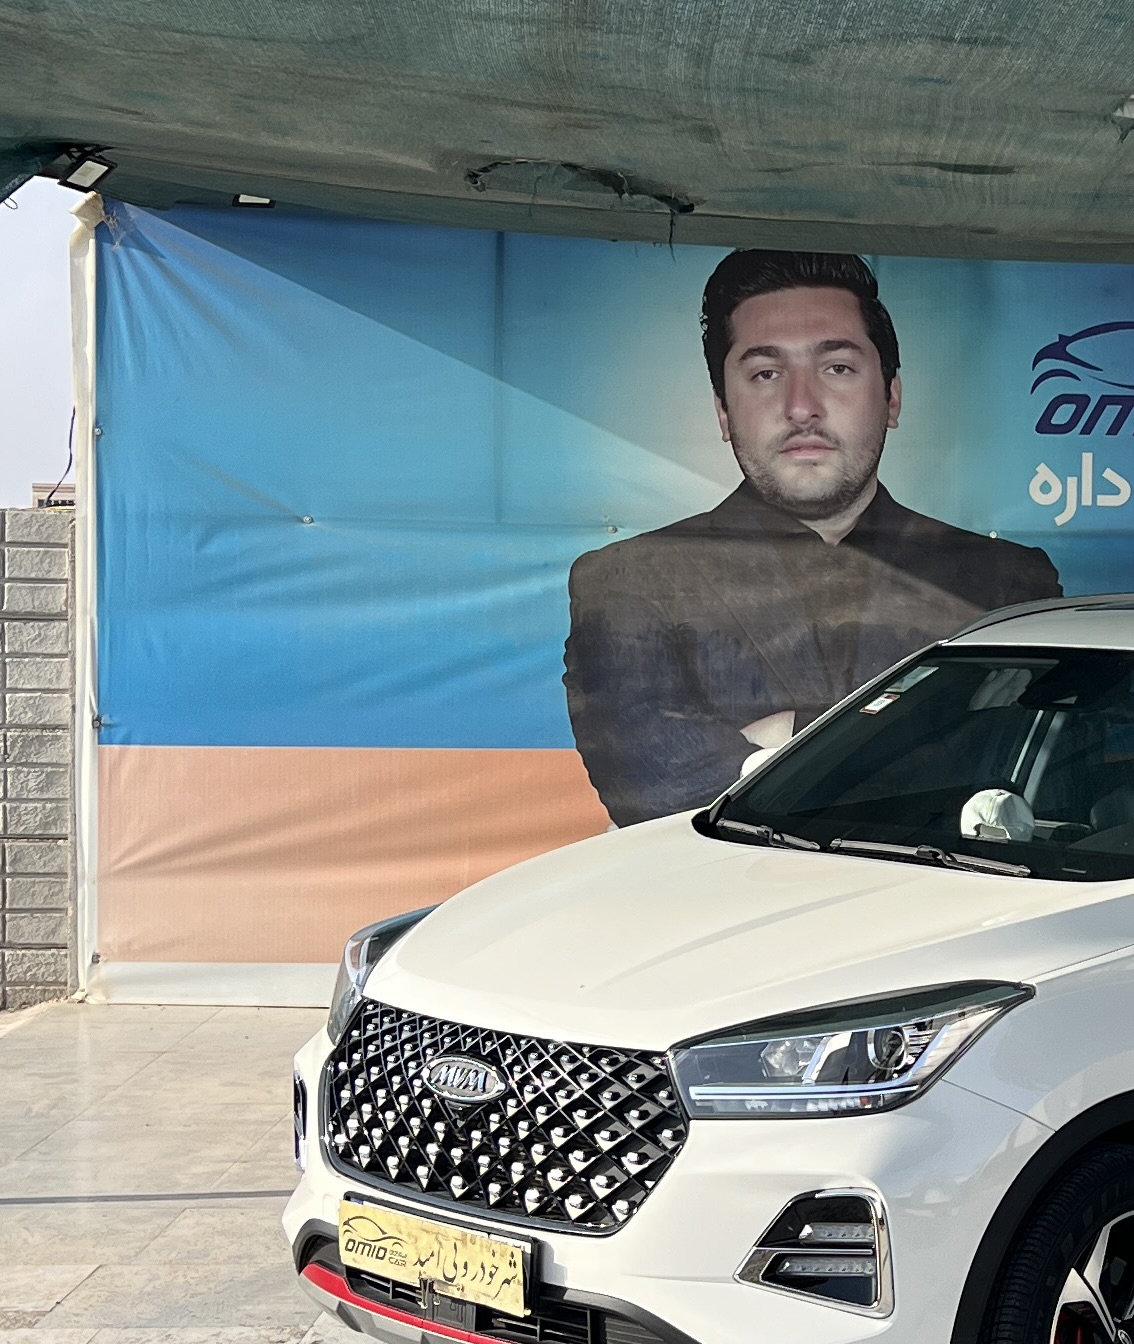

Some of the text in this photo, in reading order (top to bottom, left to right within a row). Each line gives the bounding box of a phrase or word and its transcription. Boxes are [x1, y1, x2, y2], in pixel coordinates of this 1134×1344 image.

[1028, 451, 1132, 527] داره
[430, 1064, 488, 1093] MVM
[344, 1237, 388, 1261] OMID
